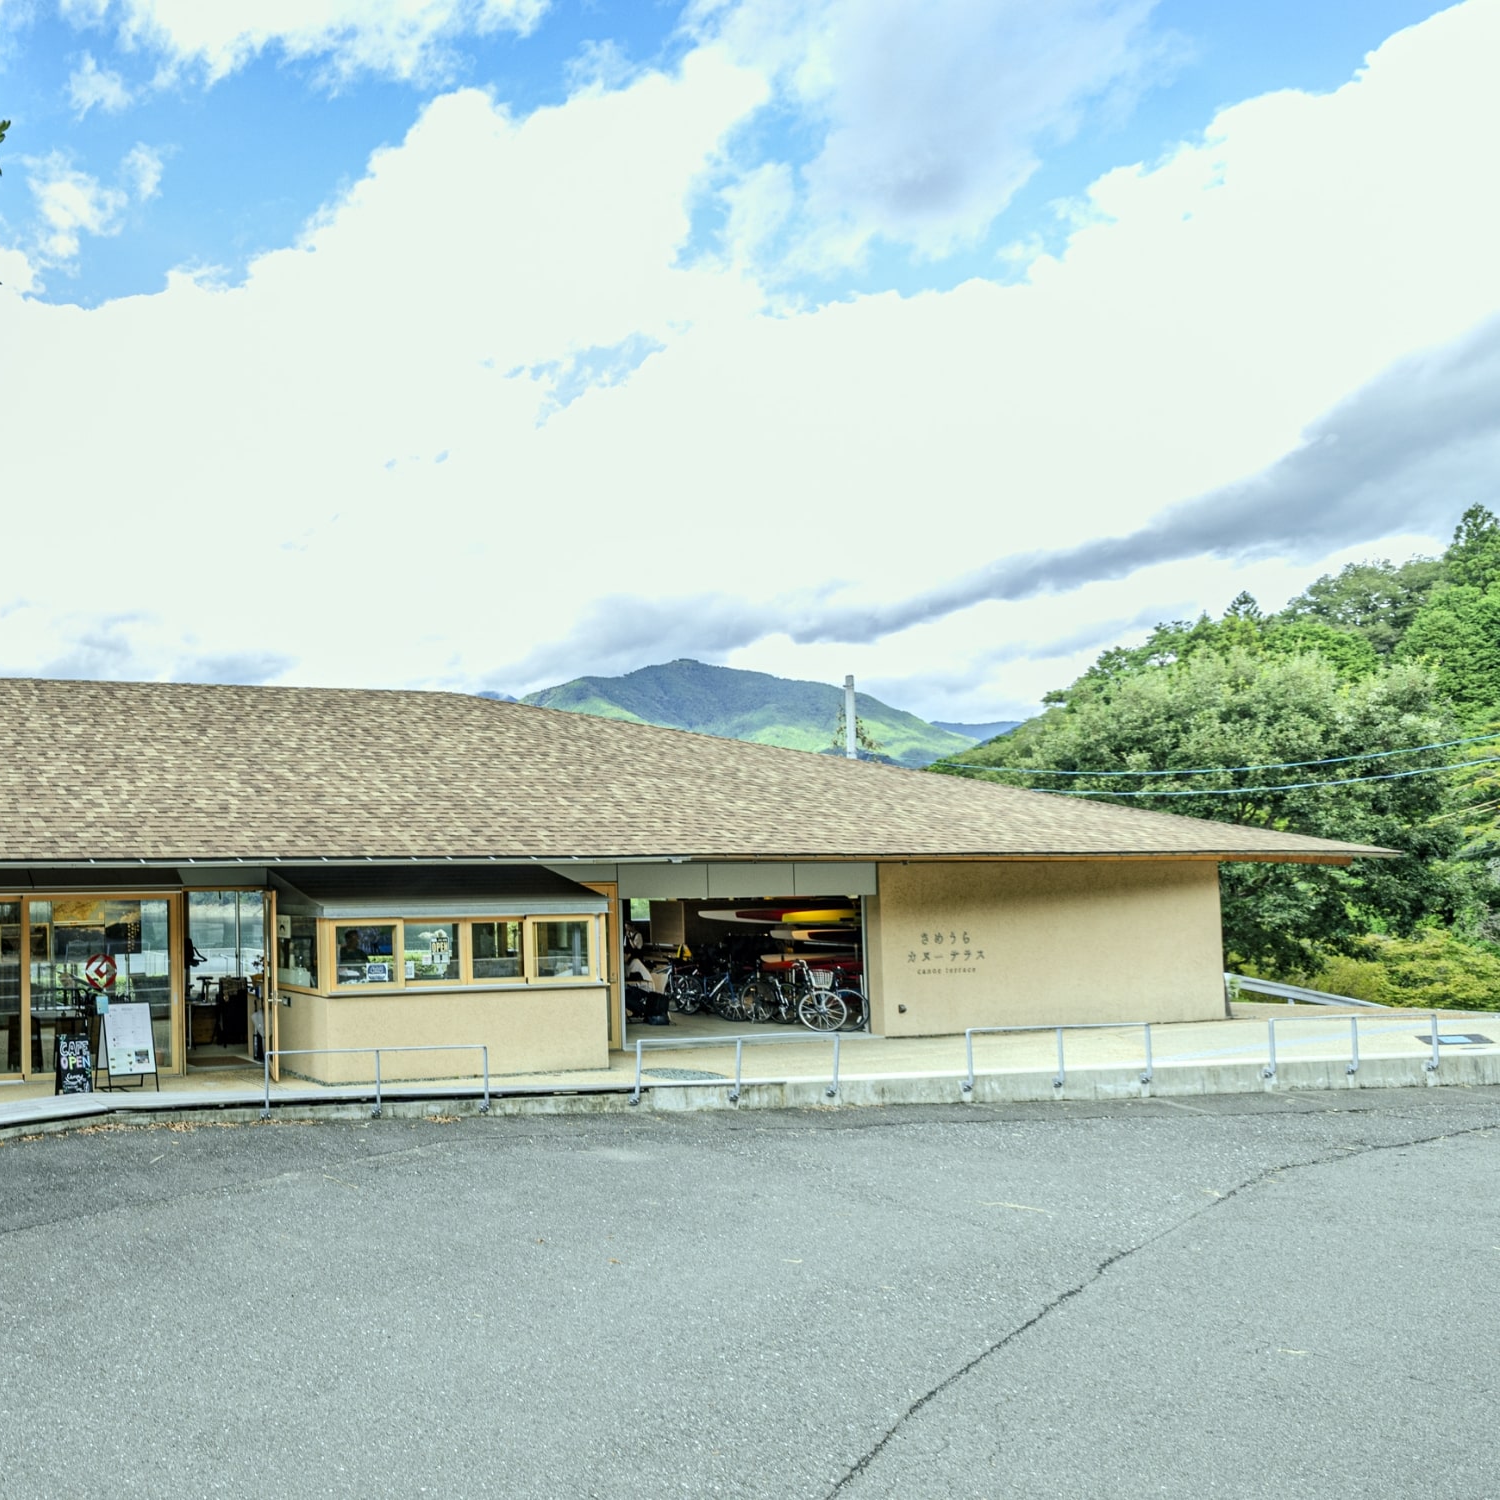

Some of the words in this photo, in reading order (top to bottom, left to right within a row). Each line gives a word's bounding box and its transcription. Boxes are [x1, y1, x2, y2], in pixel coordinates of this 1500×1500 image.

[921, 931, 970, 945] さめうら
[908, 950, 985, 963] カヌーテラス
[60, 1056, 91, 1070] OPEN
